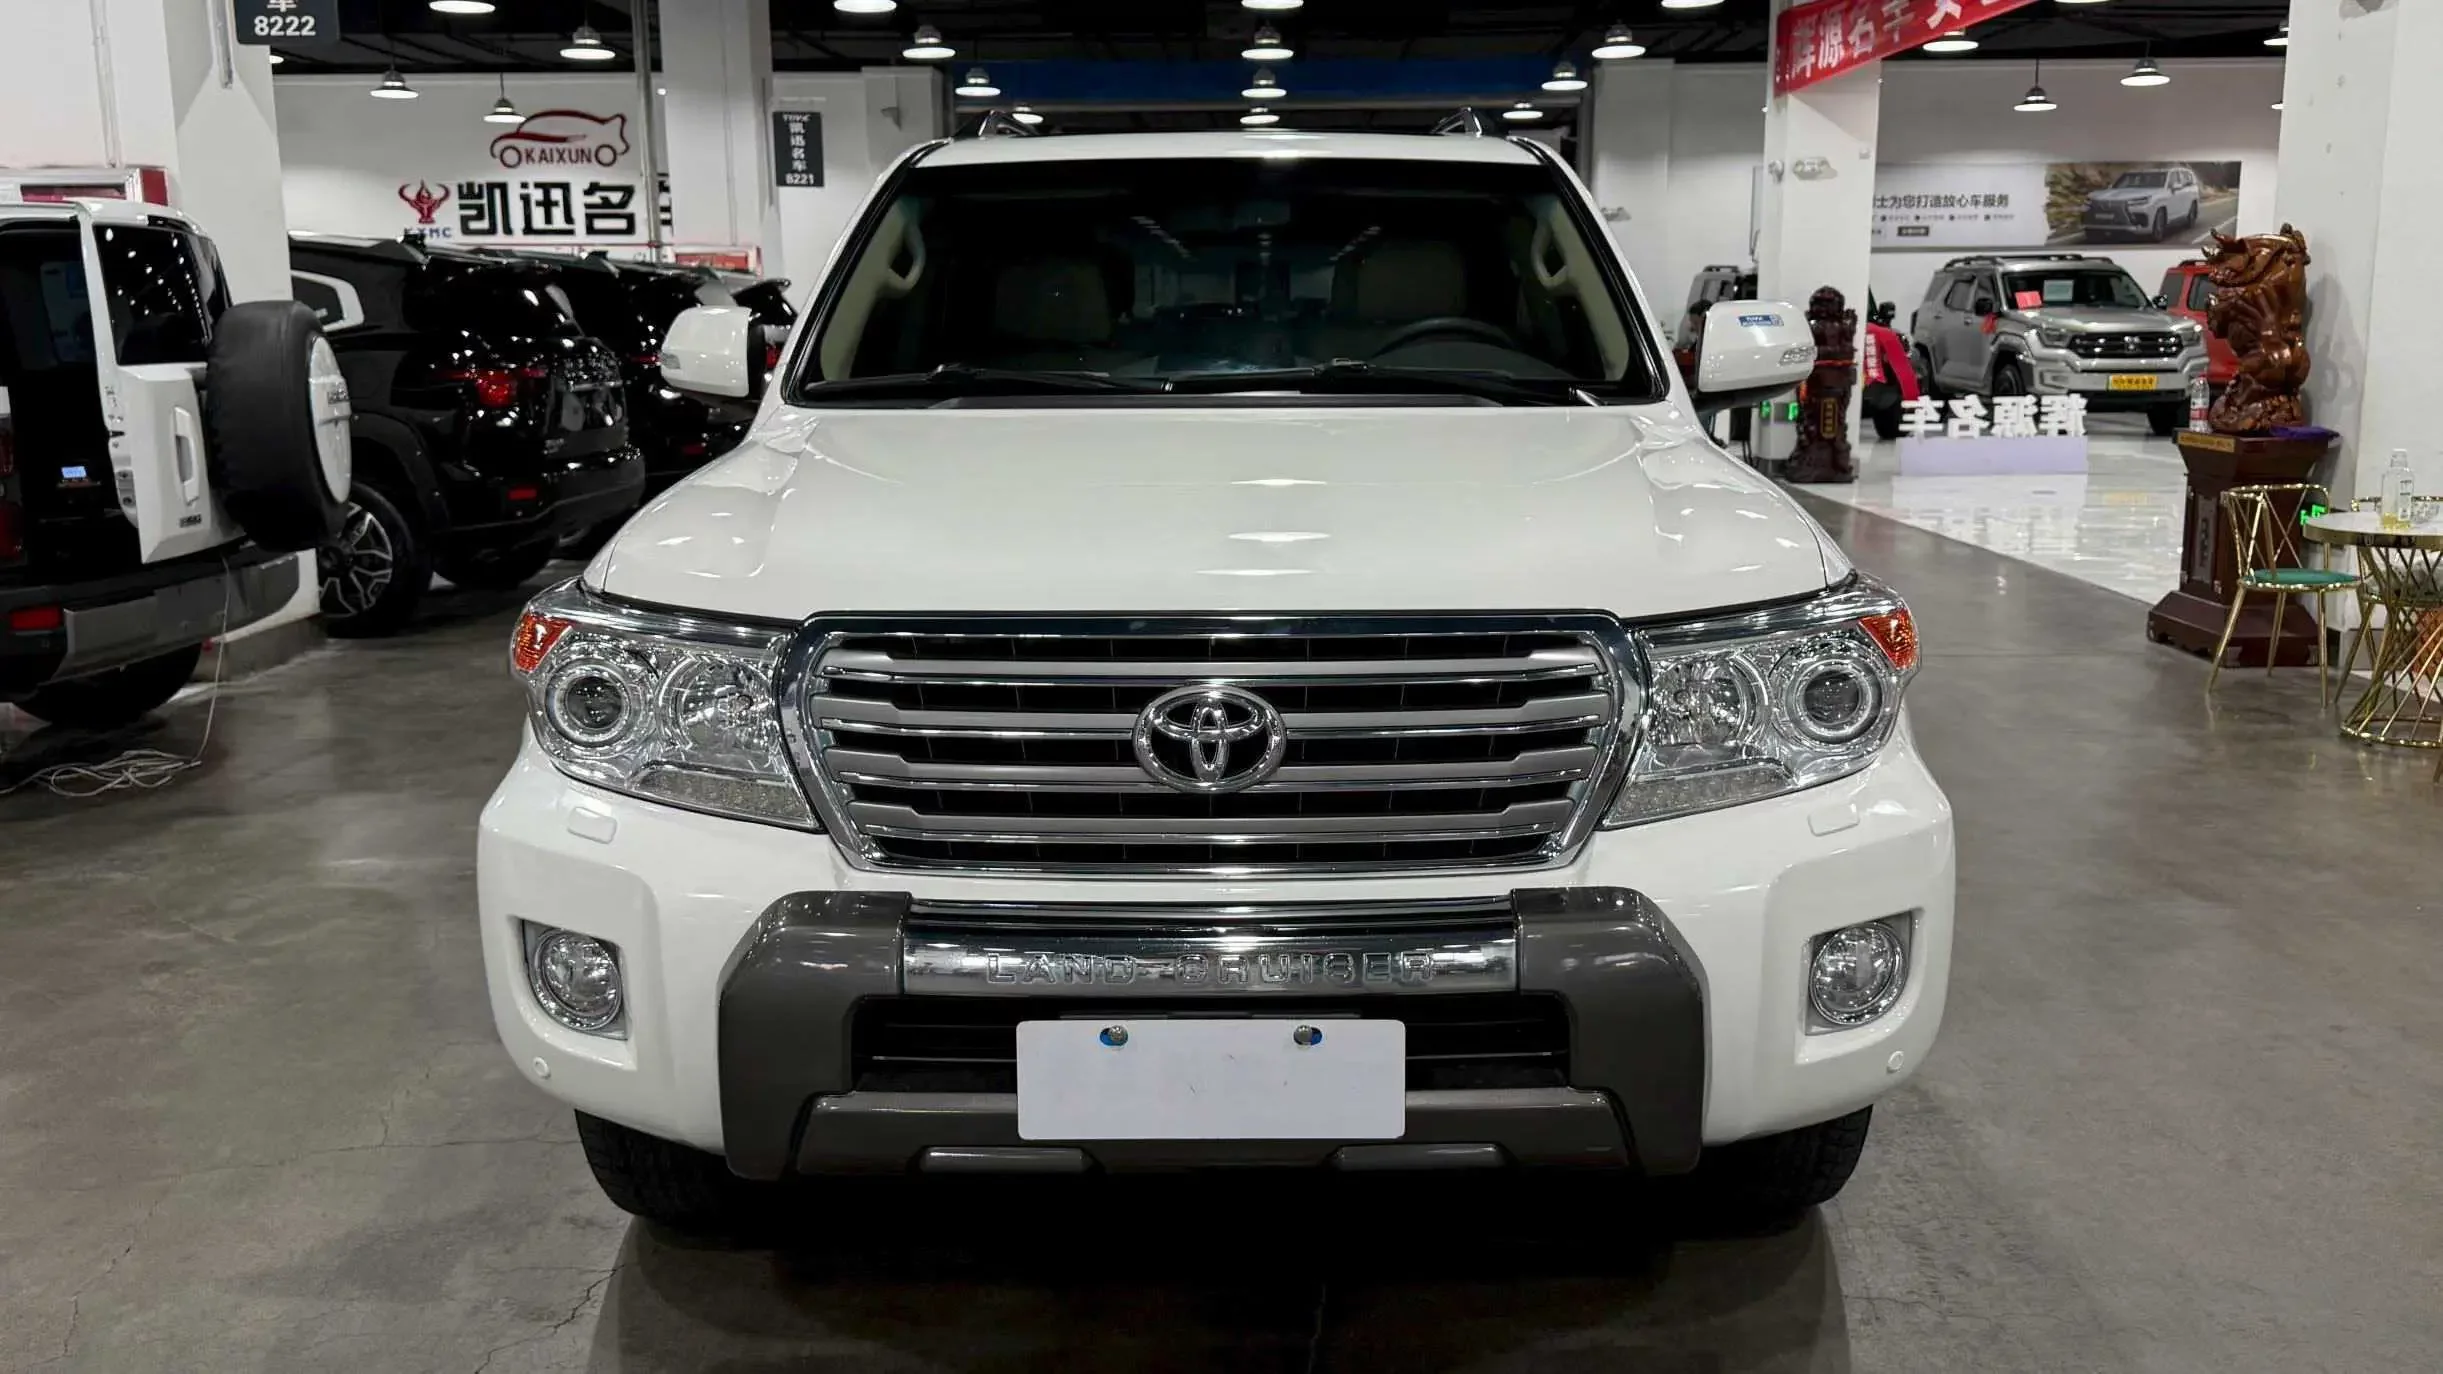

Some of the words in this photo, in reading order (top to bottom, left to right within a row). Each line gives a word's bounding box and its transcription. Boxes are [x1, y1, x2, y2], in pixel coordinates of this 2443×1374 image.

[254, 15, 316, 36] 8222
[525, 147, 592, 165] KAIXUN
[786, 173, 814, 184] 8221
[986, 953, 1136, 984] LAND
[1176, 953, 1437, 984] CRUISER
